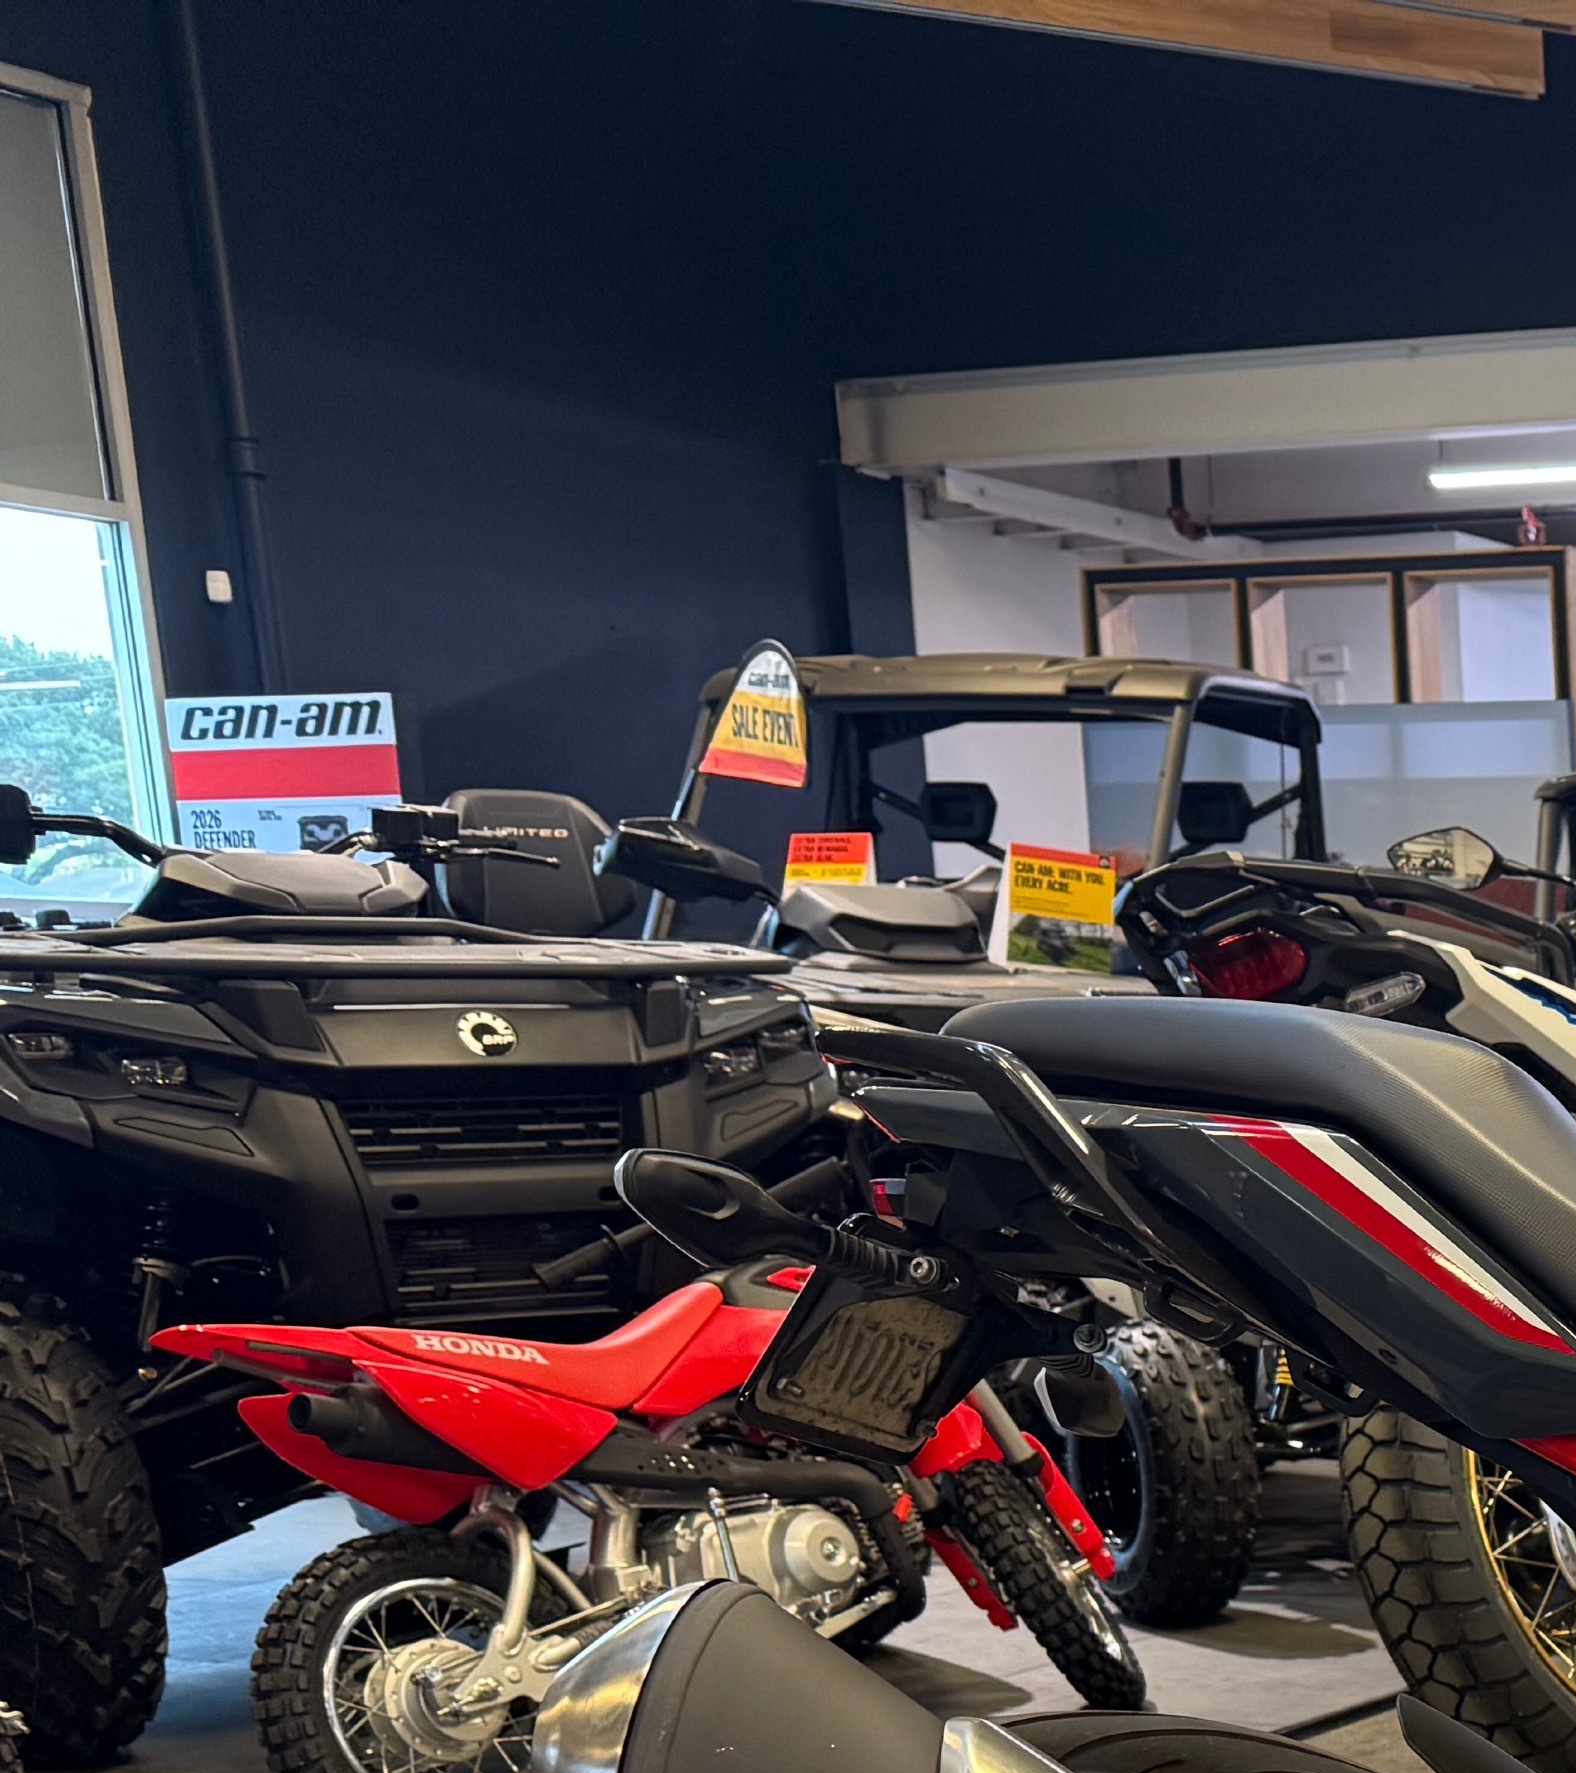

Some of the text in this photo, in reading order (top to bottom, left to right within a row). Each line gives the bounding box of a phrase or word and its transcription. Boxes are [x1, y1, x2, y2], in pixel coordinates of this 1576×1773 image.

[181, 699, 382, 741] can-am
[732, 704, 759, 741] SALE
[190, 809, 222, 829] 2026
[193, 829, 258, 850] DEFENDER
[411, 1334, 551, 1366] HONDA
